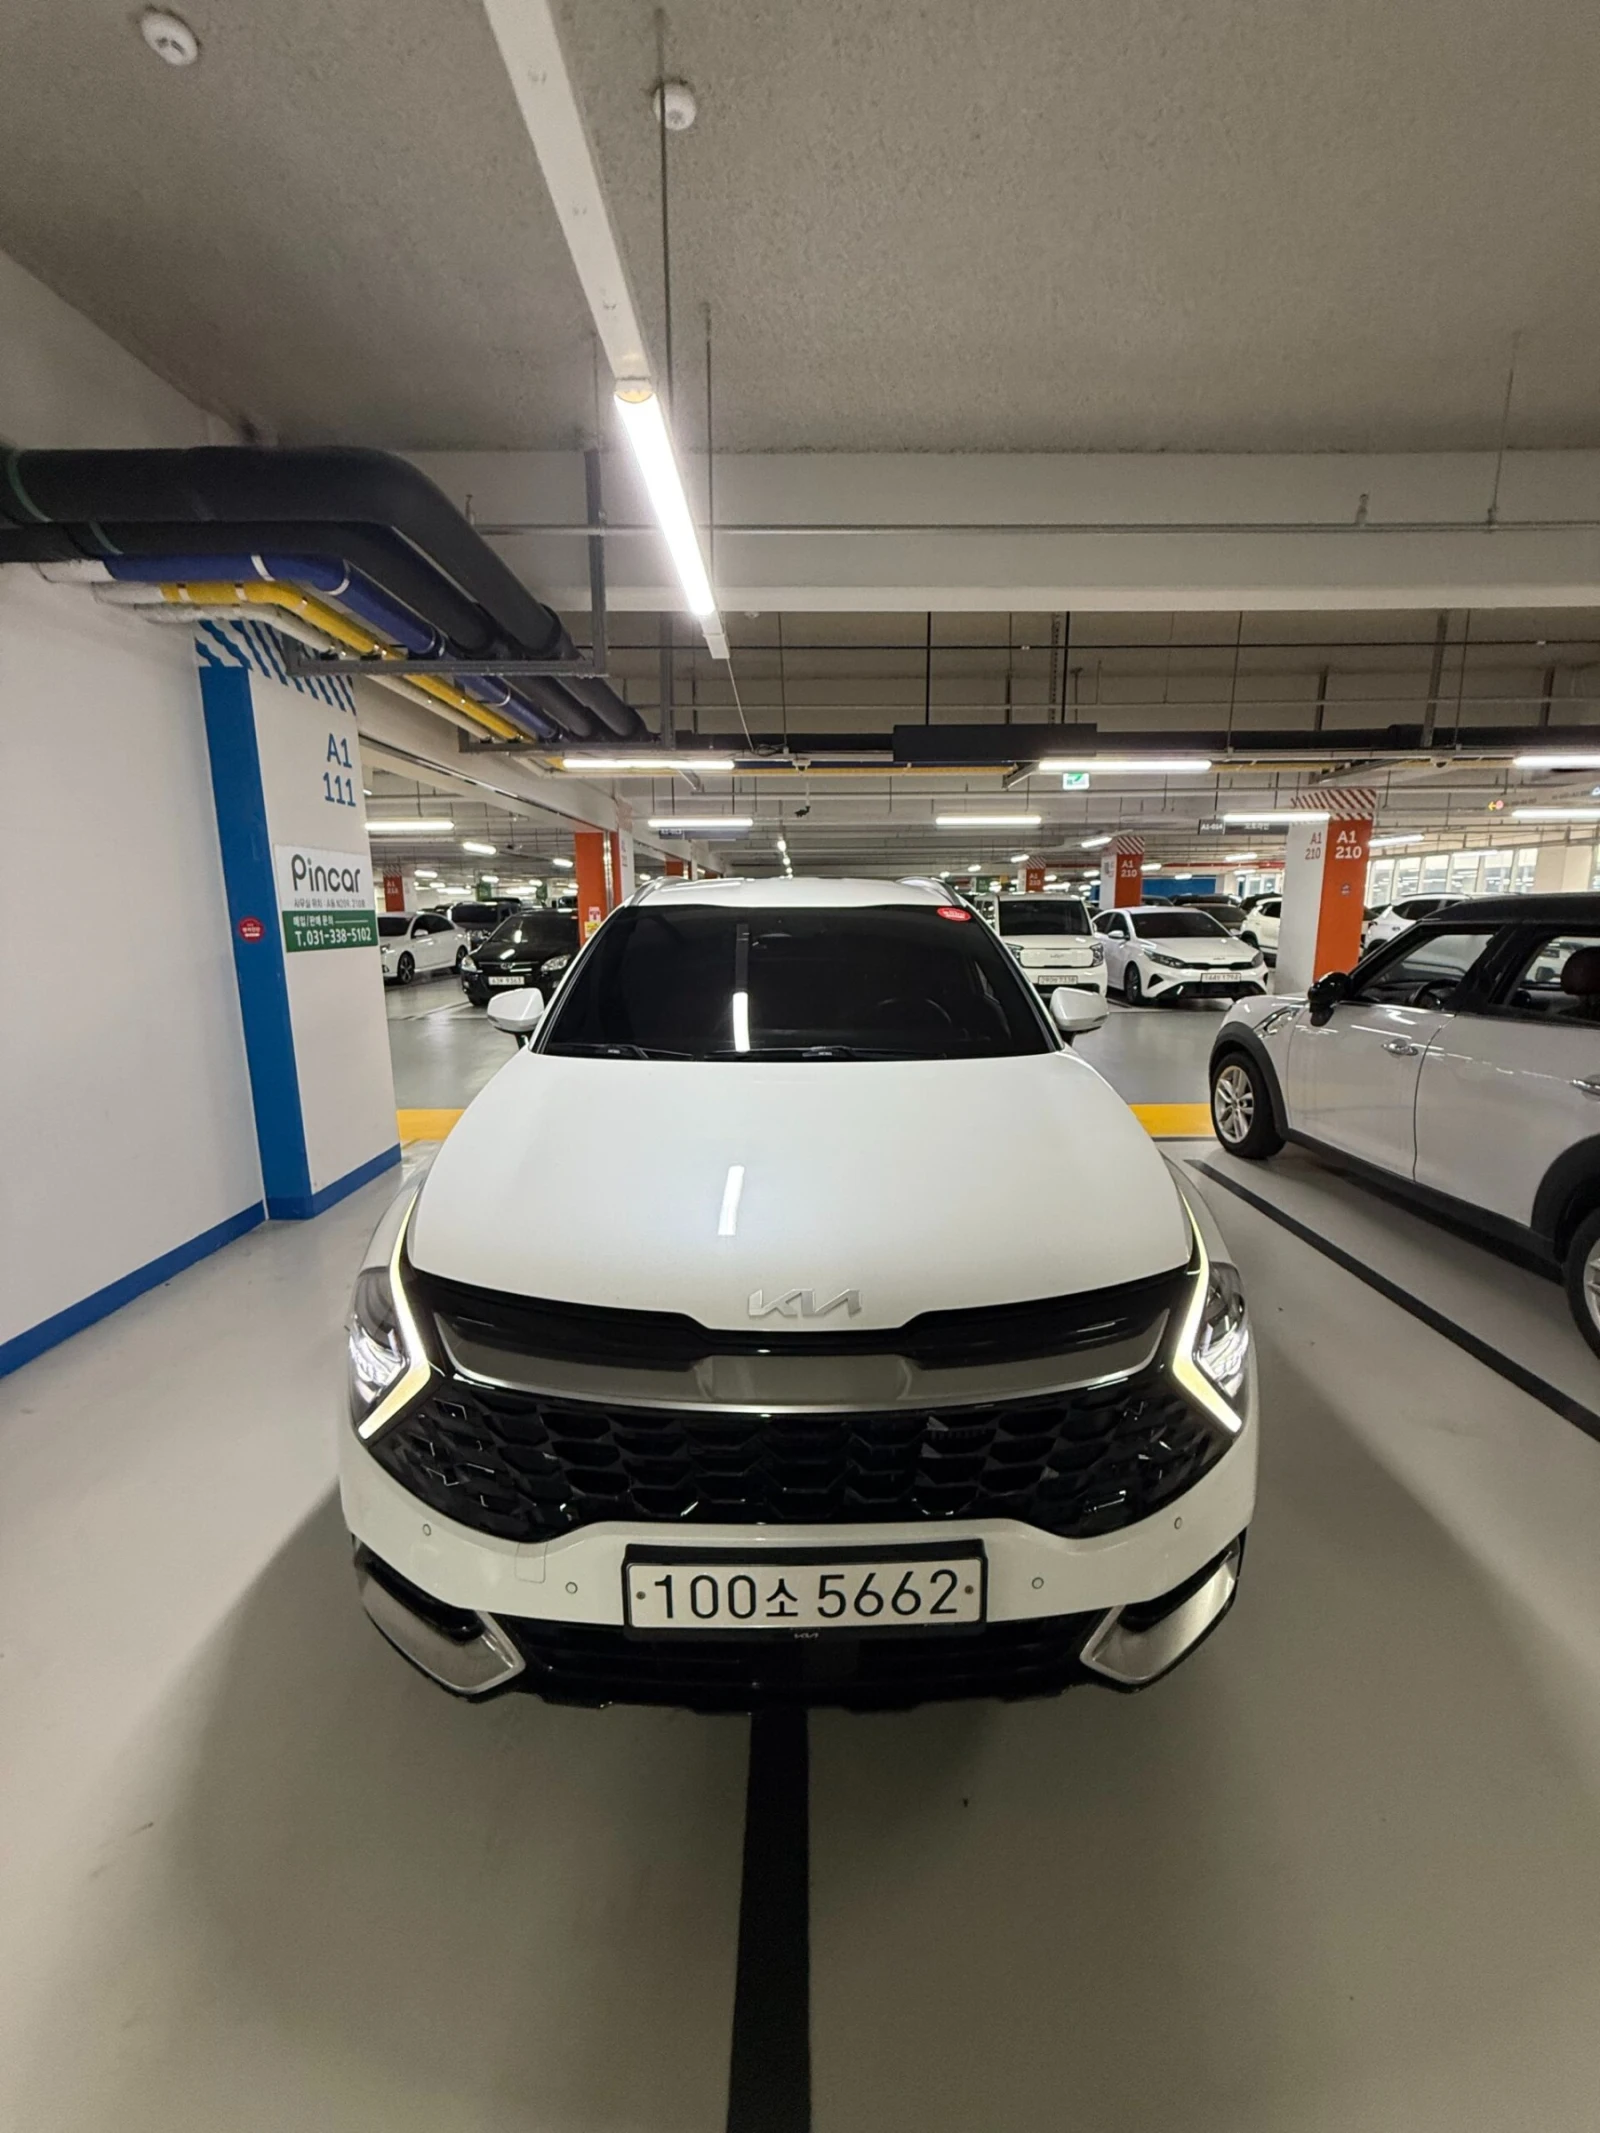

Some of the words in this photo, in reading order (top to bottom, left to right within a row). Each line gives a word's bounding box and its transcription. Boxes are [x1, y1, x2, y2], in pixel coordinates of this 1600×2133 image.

[327, 733, 352, 768] A1
[323, 772, 356, 807] 111
[1310, 832, 1322, 845] A1
[1336, 831, 1357, 844] A1
[1305, 847, 1321, 860] 210
[1335, 846, 1362, 860] 210
[1121, 860, 1134, 868] A1
[291, 853, 361, 893] Pincar
[1121, 869, 1137, 878] 210
[295, 927, 372, 947] T.031-338-5102
[748, 1288, 862, 1319] KIA
[655, 1574, 799, 1619] 100소
[817, 1569, 958, 1618] 5662
